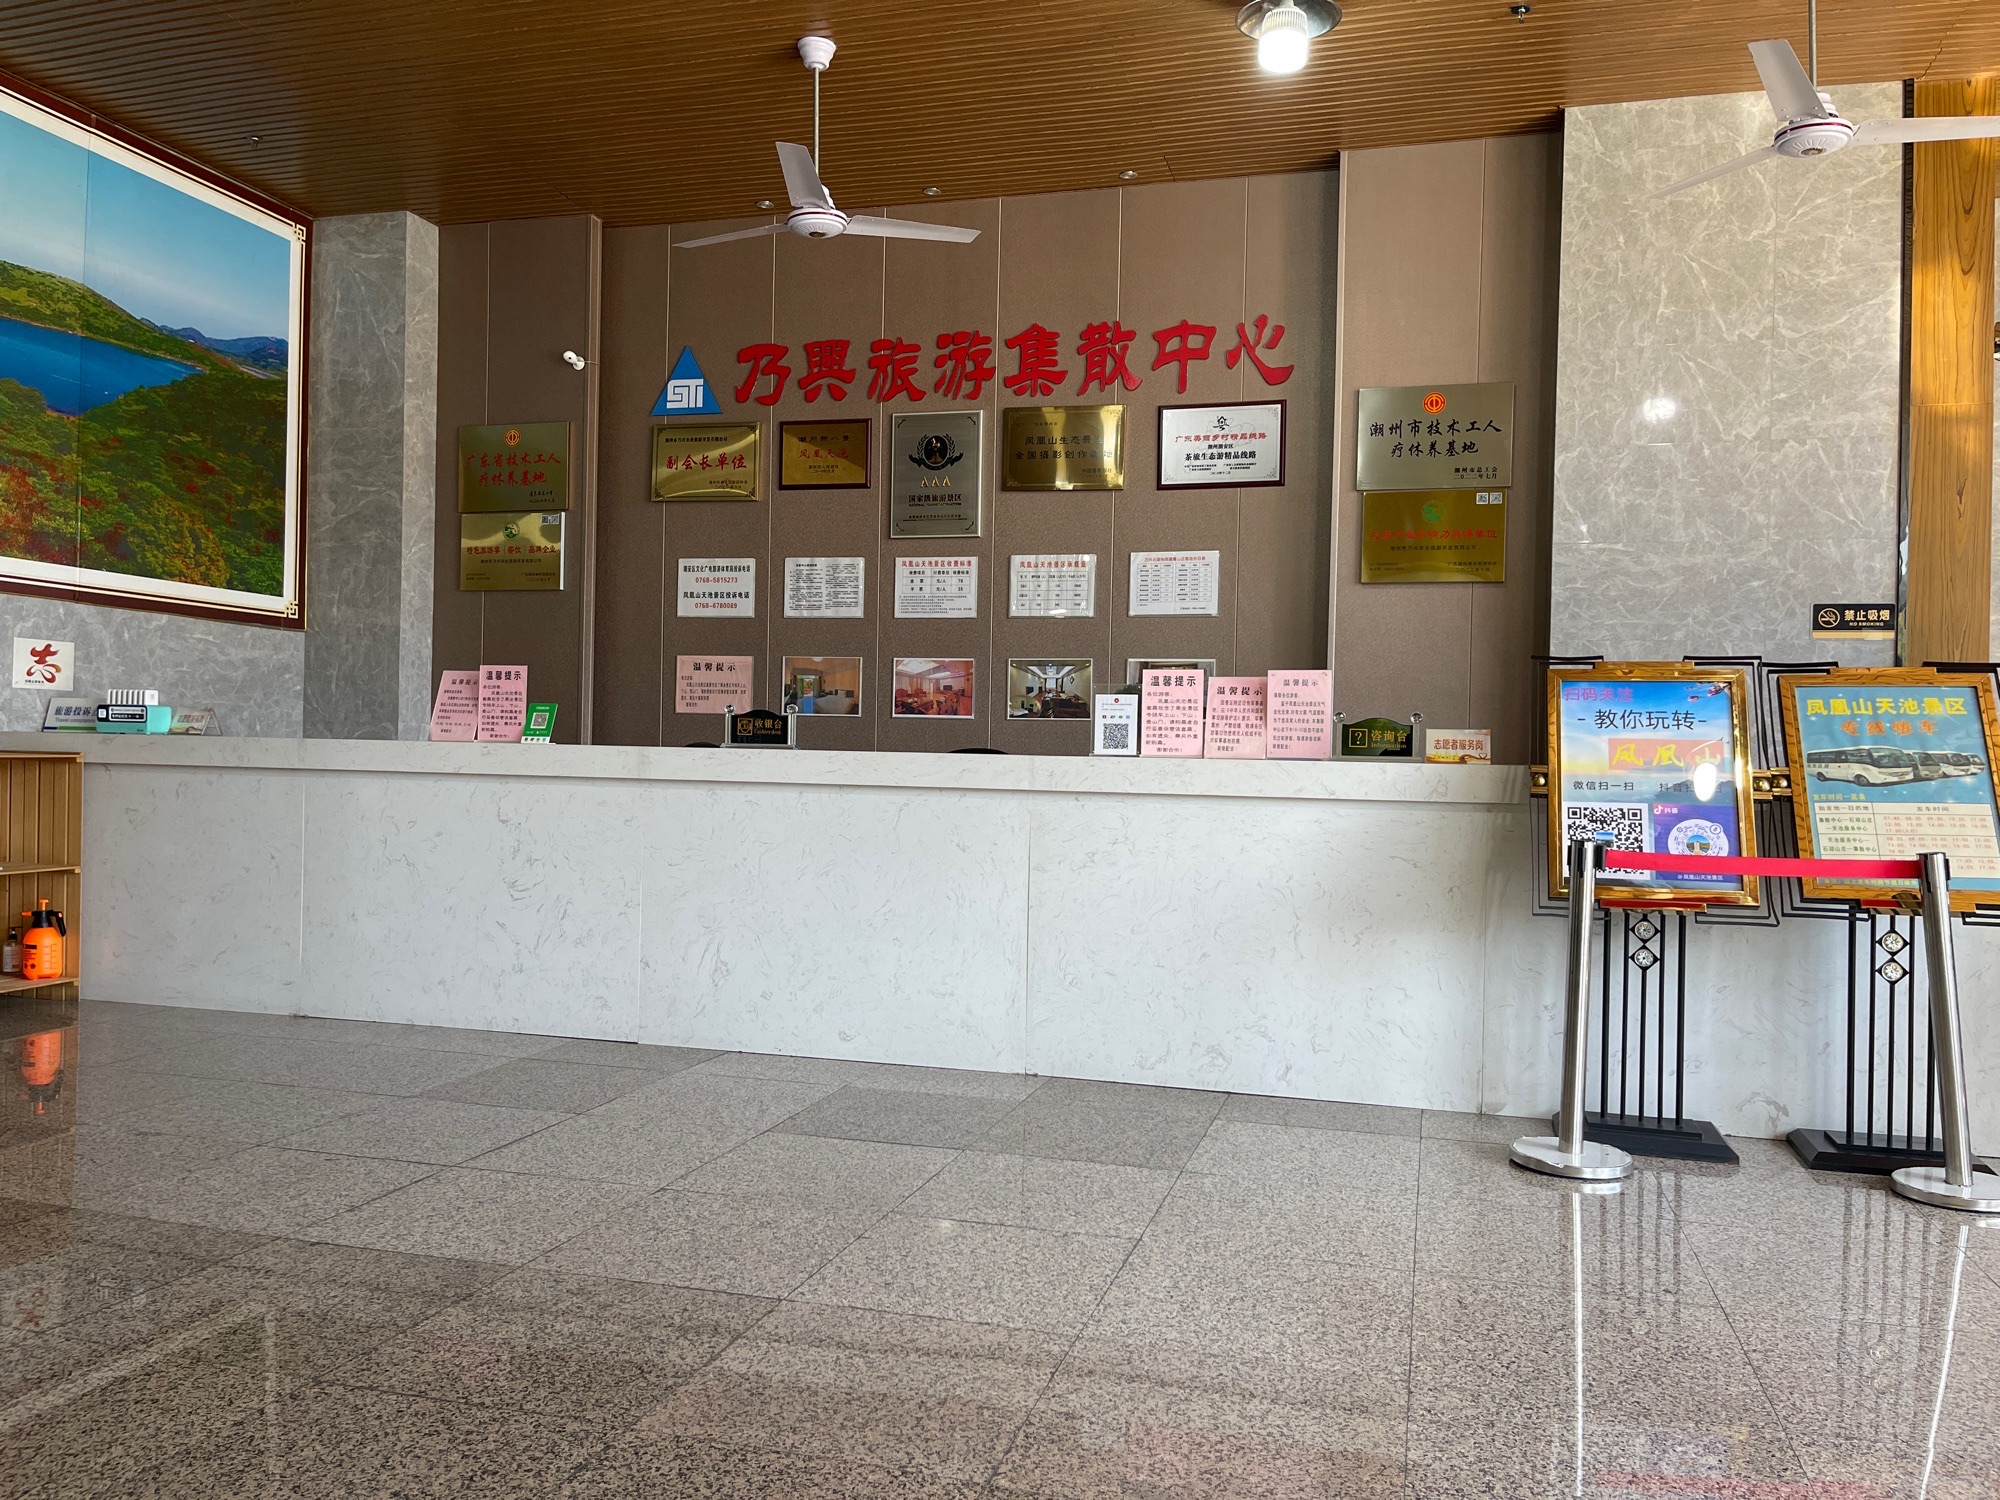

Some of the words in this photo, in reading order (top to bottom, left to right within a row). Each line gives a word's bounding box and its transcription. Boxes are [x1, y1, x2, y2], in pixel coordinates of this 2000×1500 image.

[734, 314, 1295, 405] 乃興旅游集散中心
[1370, 418, 1502, 438] 潮州市技术工人
[798, 434, 850, 443] 潮州新八景
[1175, 432, 1267, 442] 广东美丽乡村精品线路
[799, 448, 849, 459] 凤凰天池
[1391, 440, 1479, 458] 疗休养基地
[465, 452, 561, 469] 广东省技术工人
[666, 452, 747, 471] 副会长单位
[1185, 450, 1257, 461] 茶旅生态游精品线路
[478, 471, 547, 487] 疗休养基地
[683, 591, 750, 599] 凤凰山天池景区投诉电话
[1844, 609, 1890, 621] 禁止吸烟
[693, 662, 736, 671] 温馨提示
[486, 670, 522, 680] 温馨提示
[1151, 675, 1196, 687] 温馨提示
[1216, 686, 1262, 695] 温馨提示
[1565, 687, 1634, 701] 扫码关注
[1806, 697, 1968, 715] 凤凰山天池景区
[754, 719, 782, 729] 收银台
[1371, 729, 1407, 742] 咨询台
[1434, 739, 1484, 751] 志愿者服务岗
[1612, 743, 1721, 767] 凤凰山
[1573, 780, 1634, 791] 微信扫一扫
